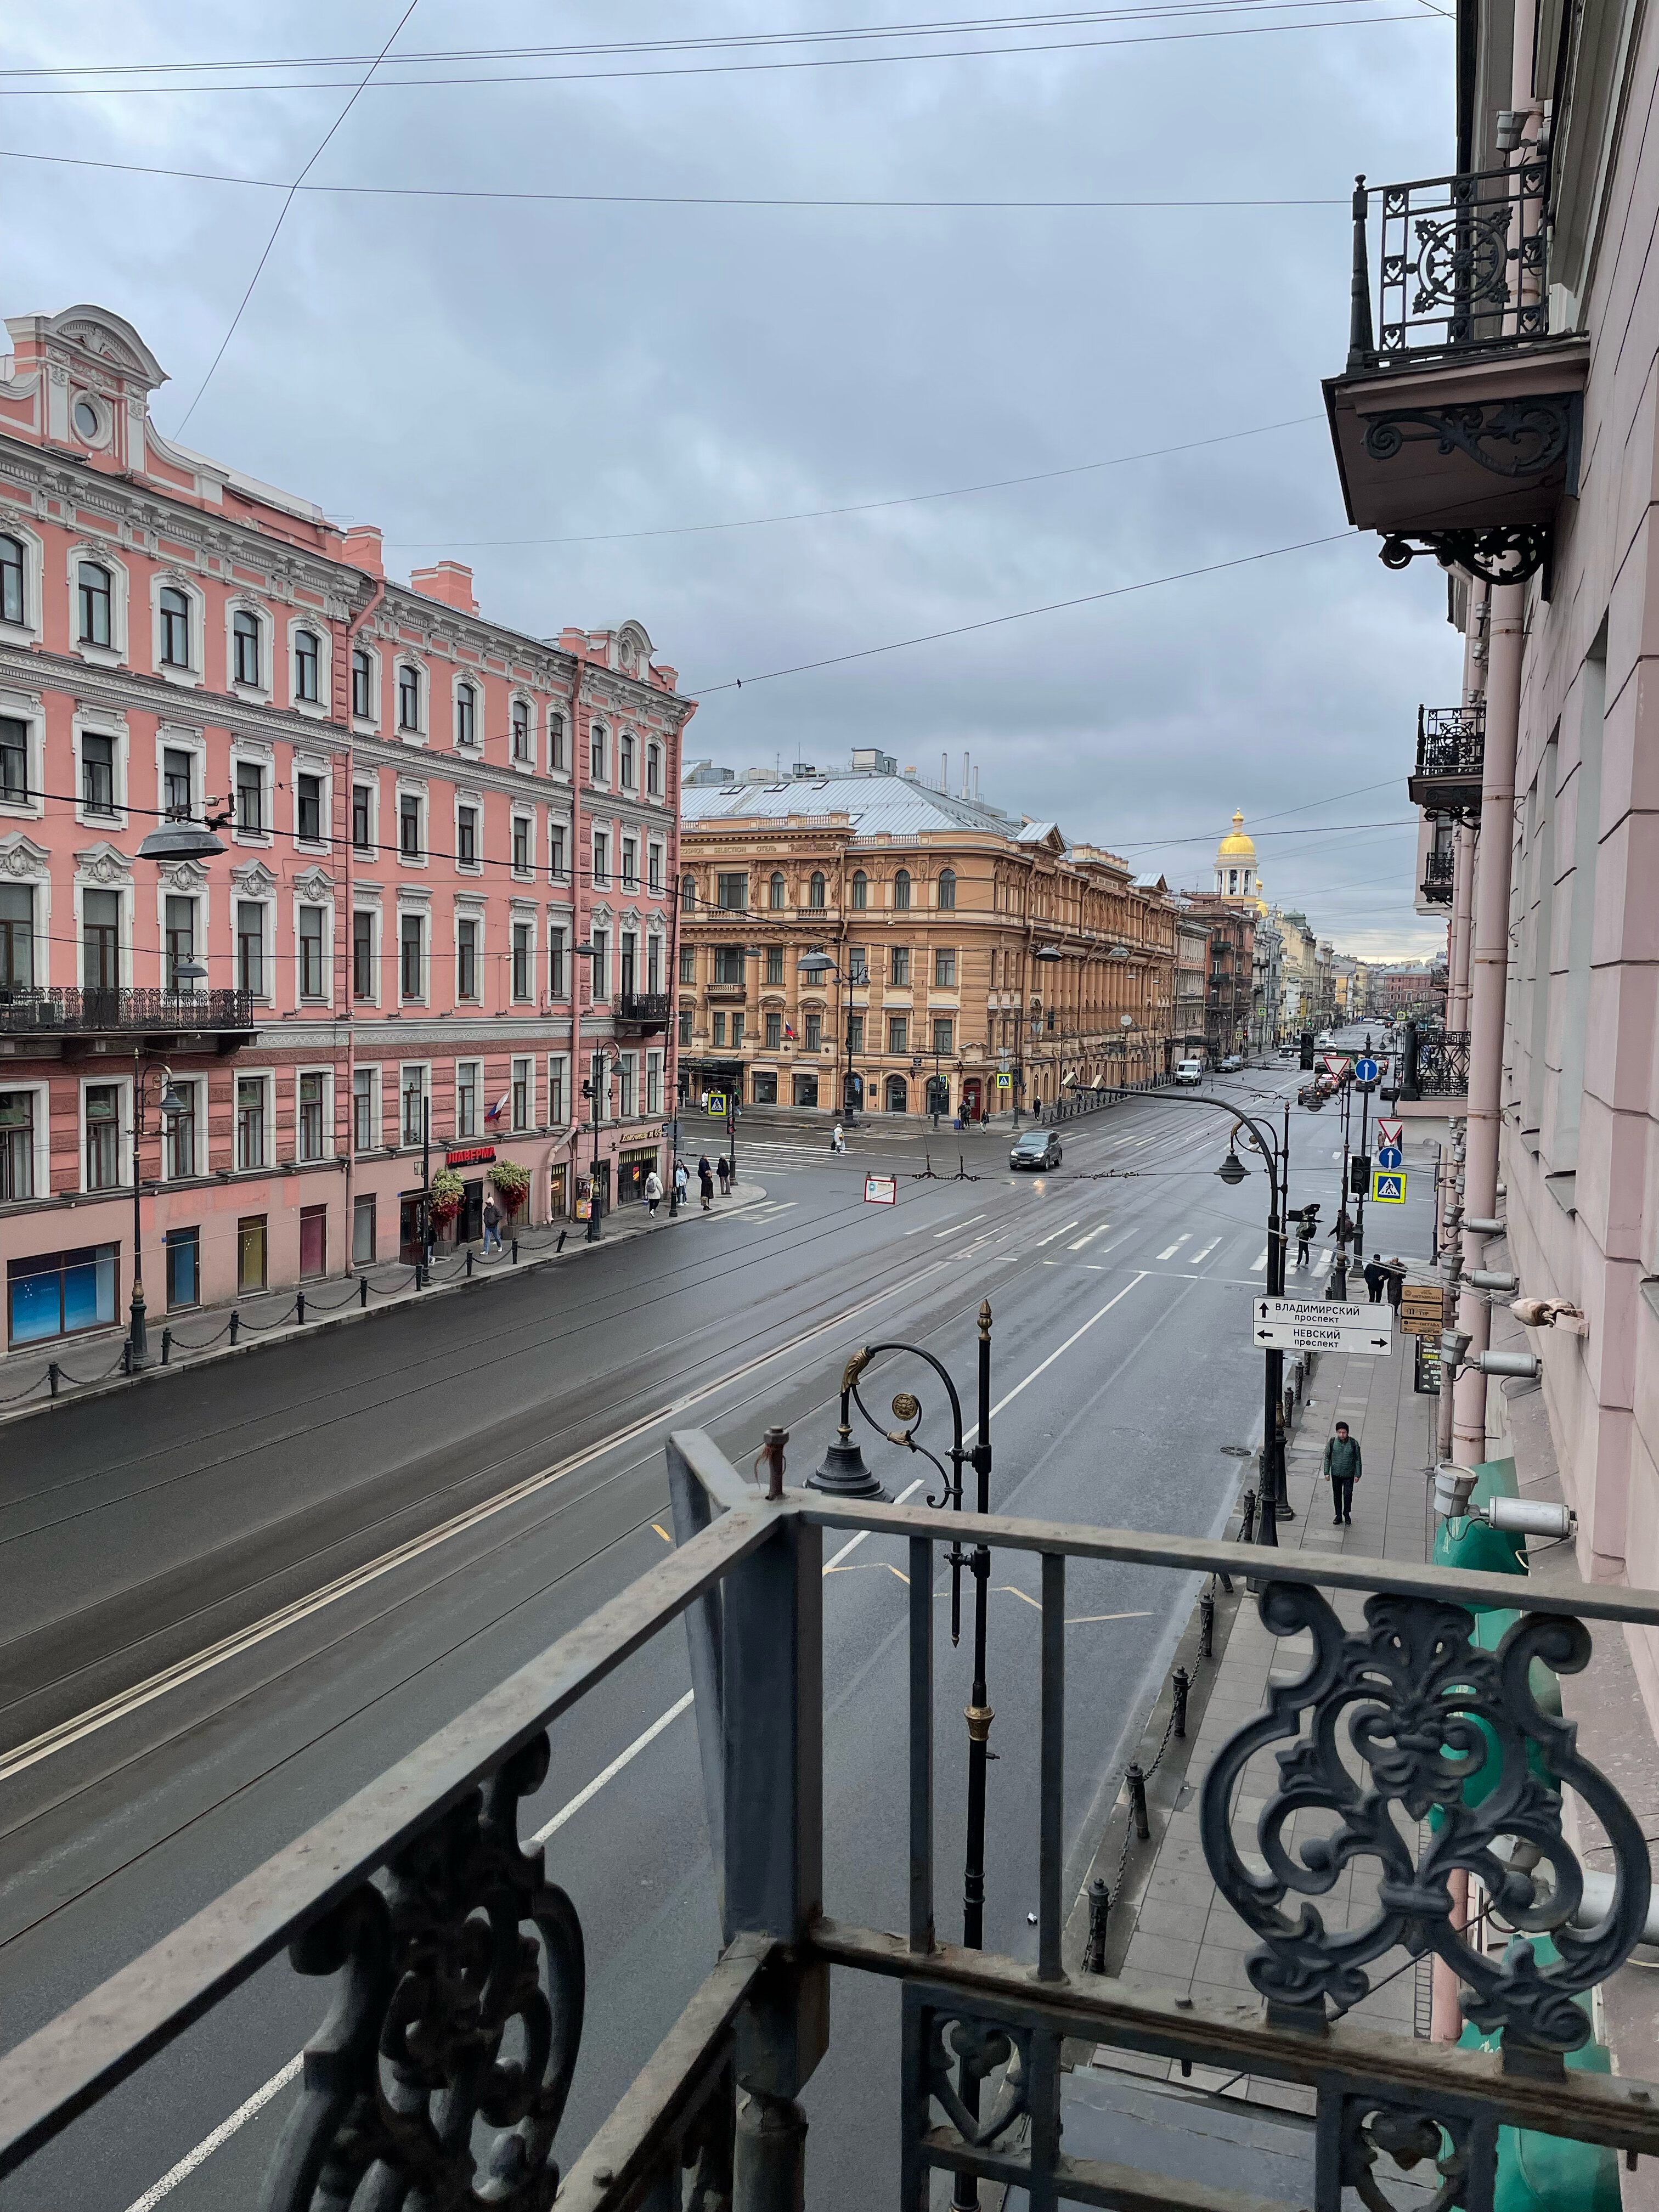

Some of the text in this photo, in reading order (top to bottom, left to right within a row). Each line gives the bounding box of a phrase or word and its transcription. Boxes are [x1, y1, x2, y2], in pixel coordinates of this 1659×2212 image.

[446, 1147, 495, 1164] ШАВЕРМА
[1276, 1303, 1360, 1316] ВЛАДИМИРСКИЙ
[1295, 1314, 1339, 1323] проспект
[1294, 1329, 1340, 1339] НЕВСКИЙ
[1294, 1339, 1339, 1347] проспект
